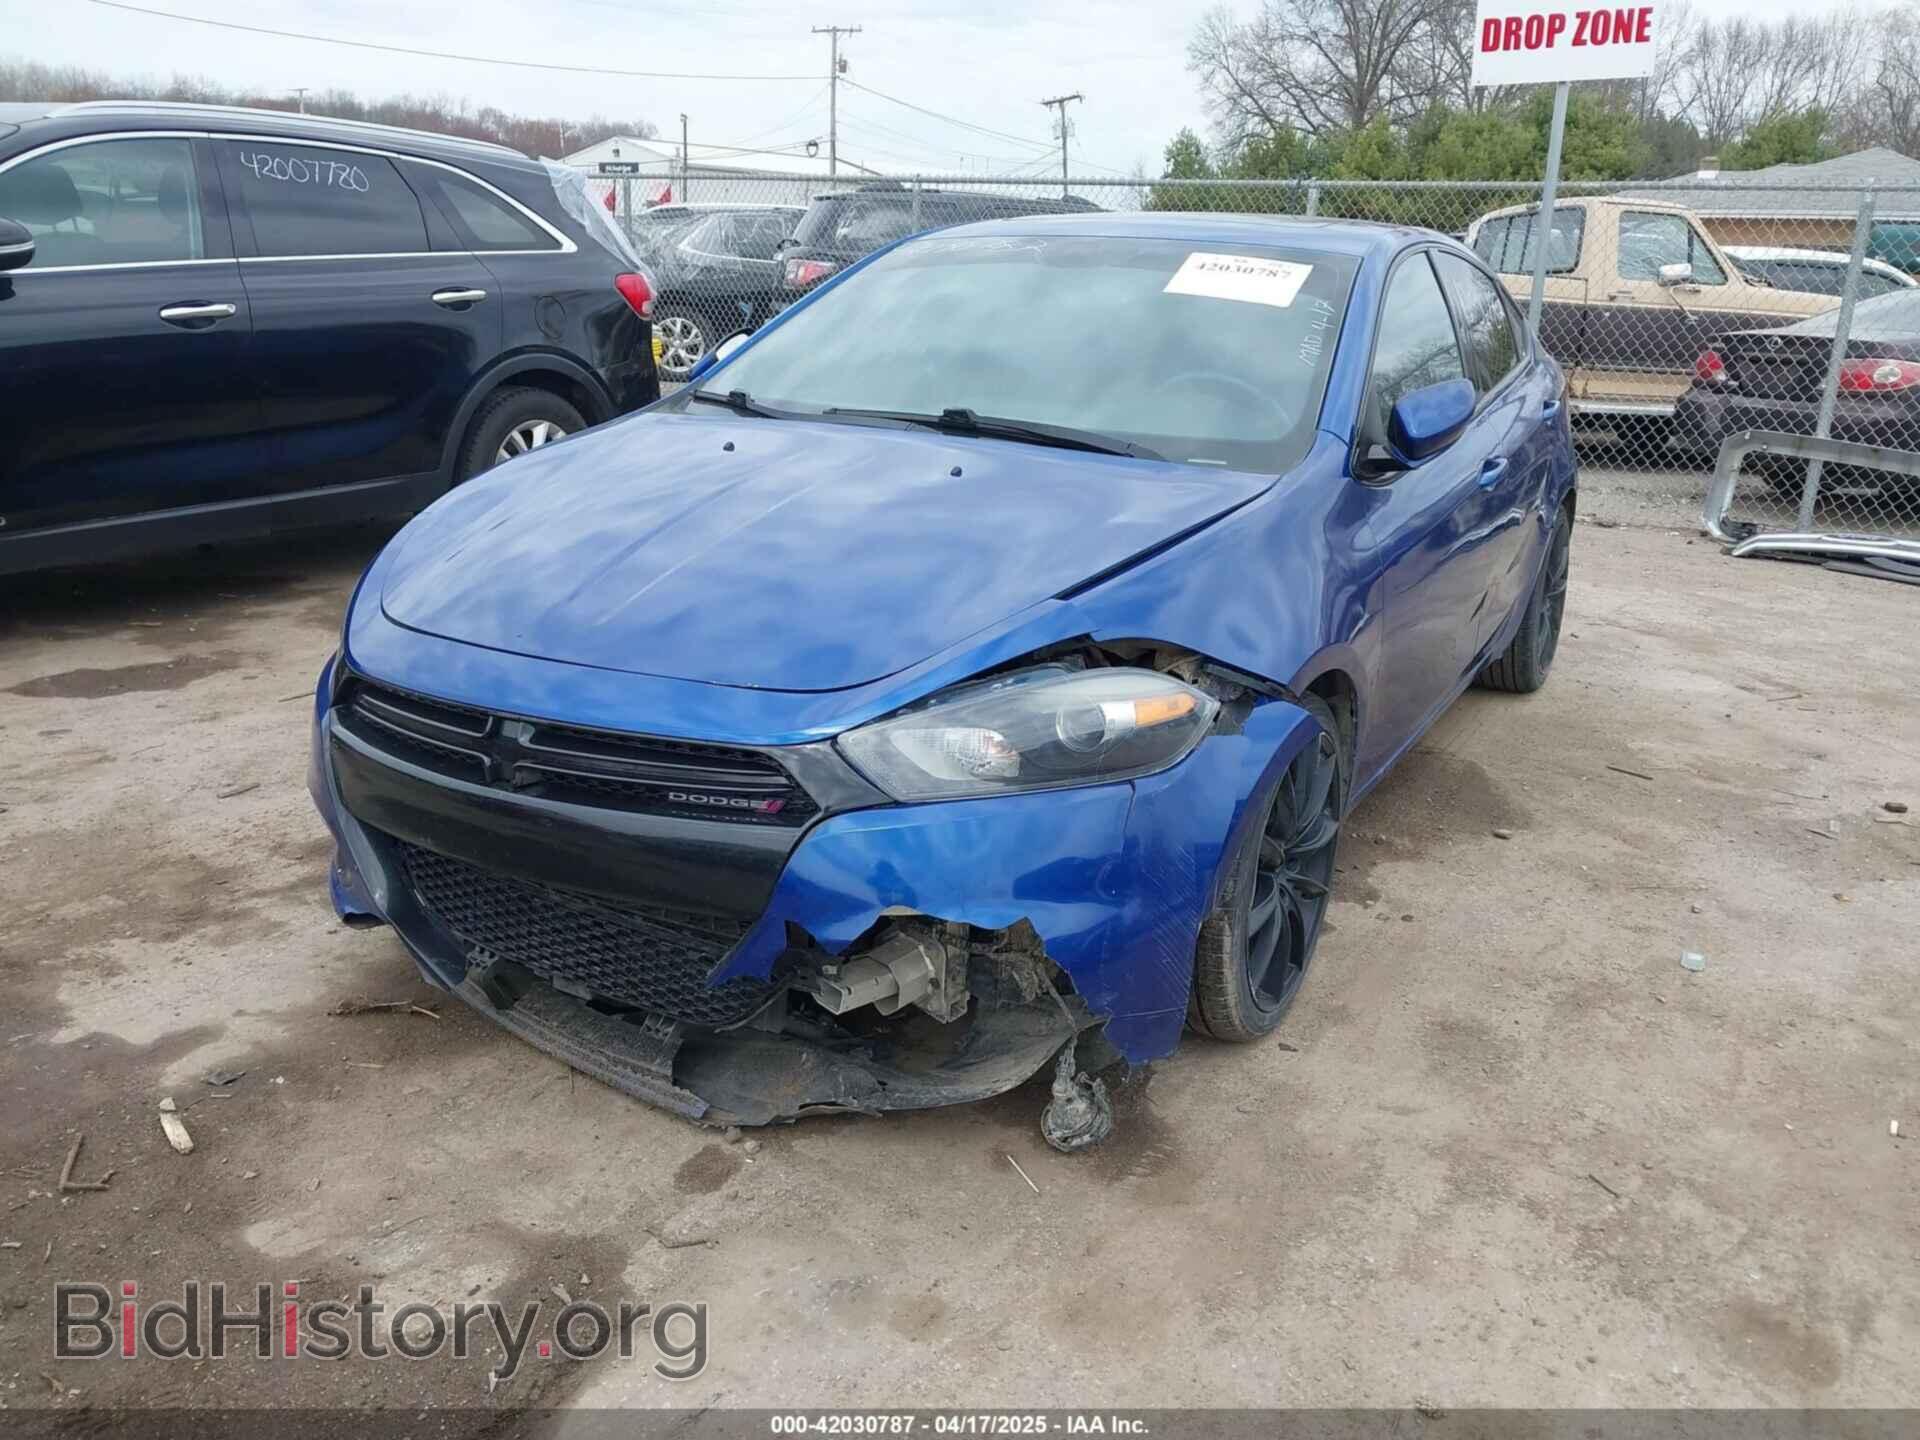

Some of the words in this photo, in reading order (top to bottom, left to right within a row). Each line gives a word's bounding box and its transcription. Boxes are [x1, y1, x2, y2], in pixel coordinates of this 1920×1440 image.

[1481, 13, 1566, 53] DROP
[1571, 7, 1653, 47] ZONE
[668, 792, 768, 810] DODGE
